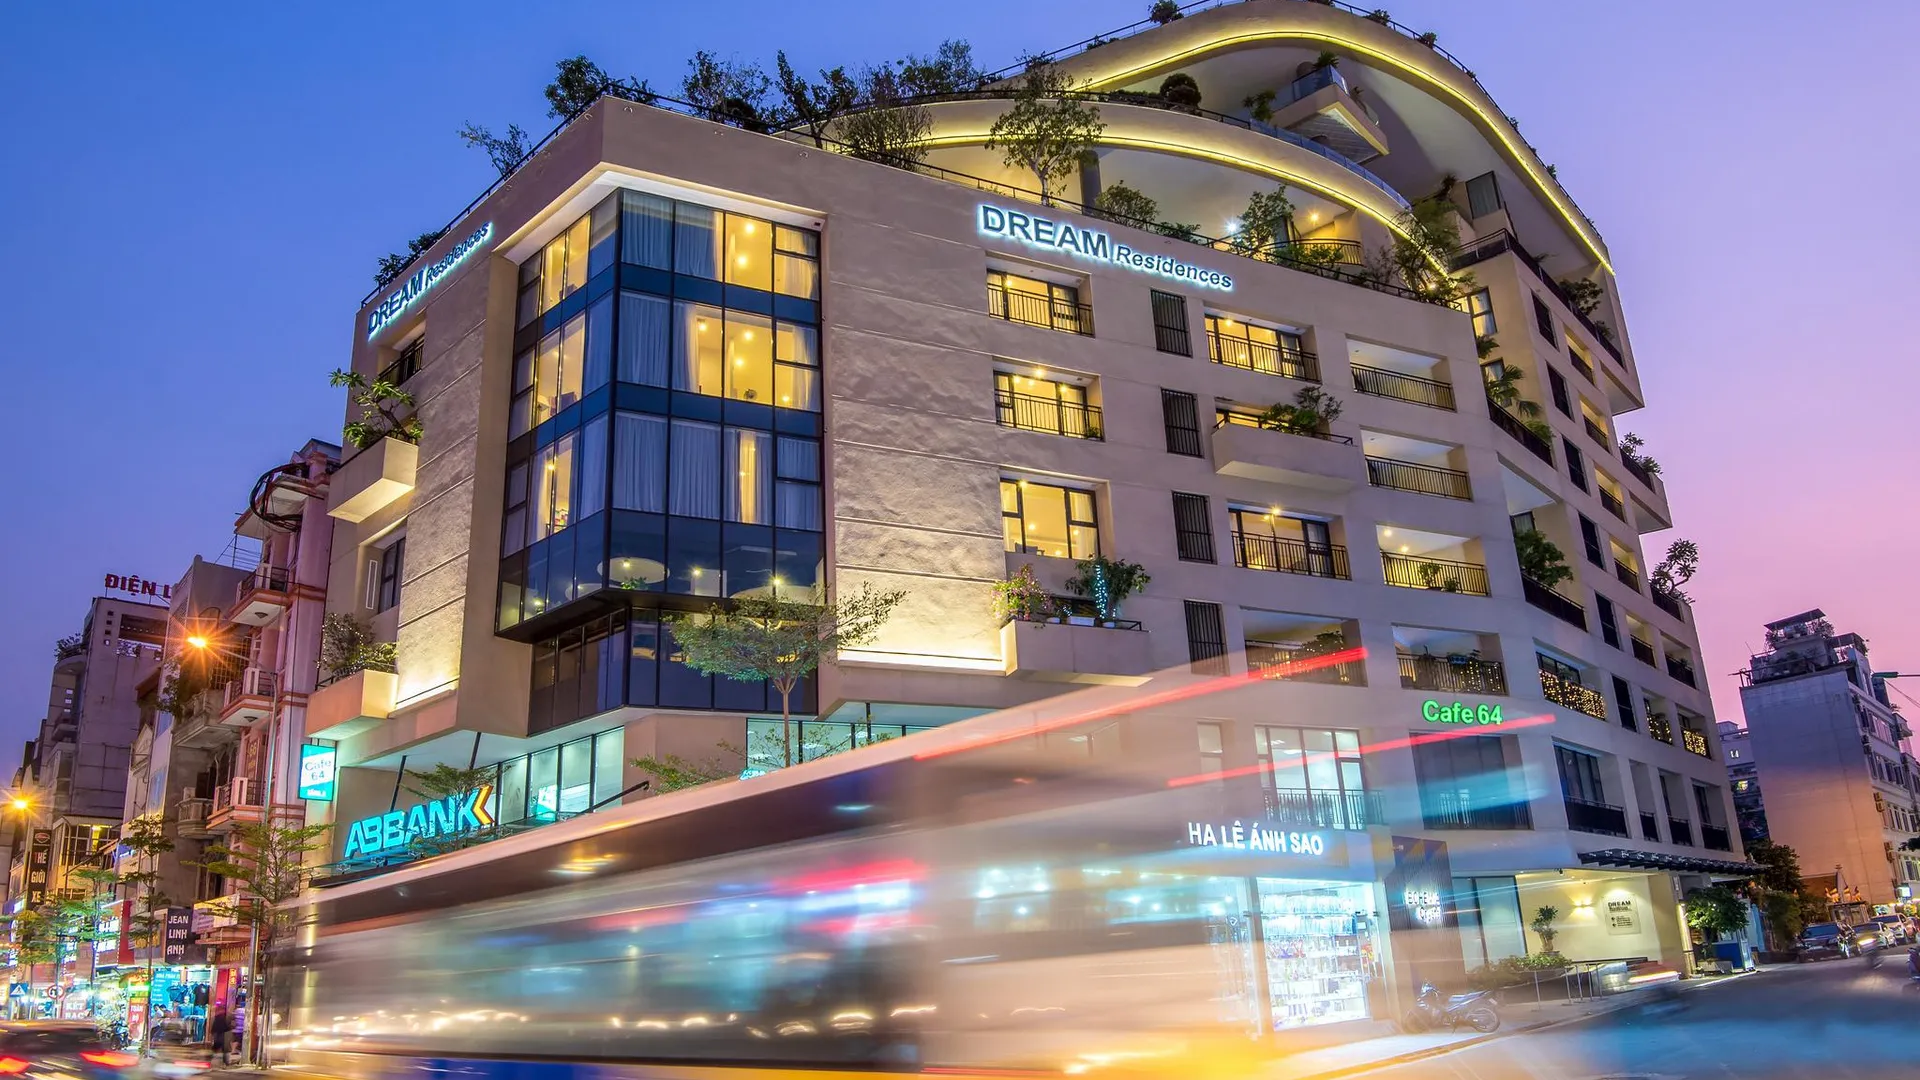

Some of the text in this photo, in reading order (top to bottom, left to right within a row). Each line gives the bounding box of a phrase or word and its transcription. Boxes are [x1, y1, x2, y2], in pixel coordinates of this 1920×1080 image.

[981, 204, 1233, 289] DREAM Residences
[368, 220, 491, 336] DREAM Residences
[105, 573, 157, 596] ĐIỆN
[1422, 699, 1504, 725] Cafe 64
[304, 759, 332, 772] Cafe
[310, 770, 325, 781] 64
[344, 785, 486, 858] ABBANK
[1221, 820, 1246, 849] LÊ
[1250, 822, 1287, 853] ÁNH
[1289, 832, 1324, 856] SAO
[168, 915, 189, 924] JEAN
[168, 929, 188, 939] LINH
